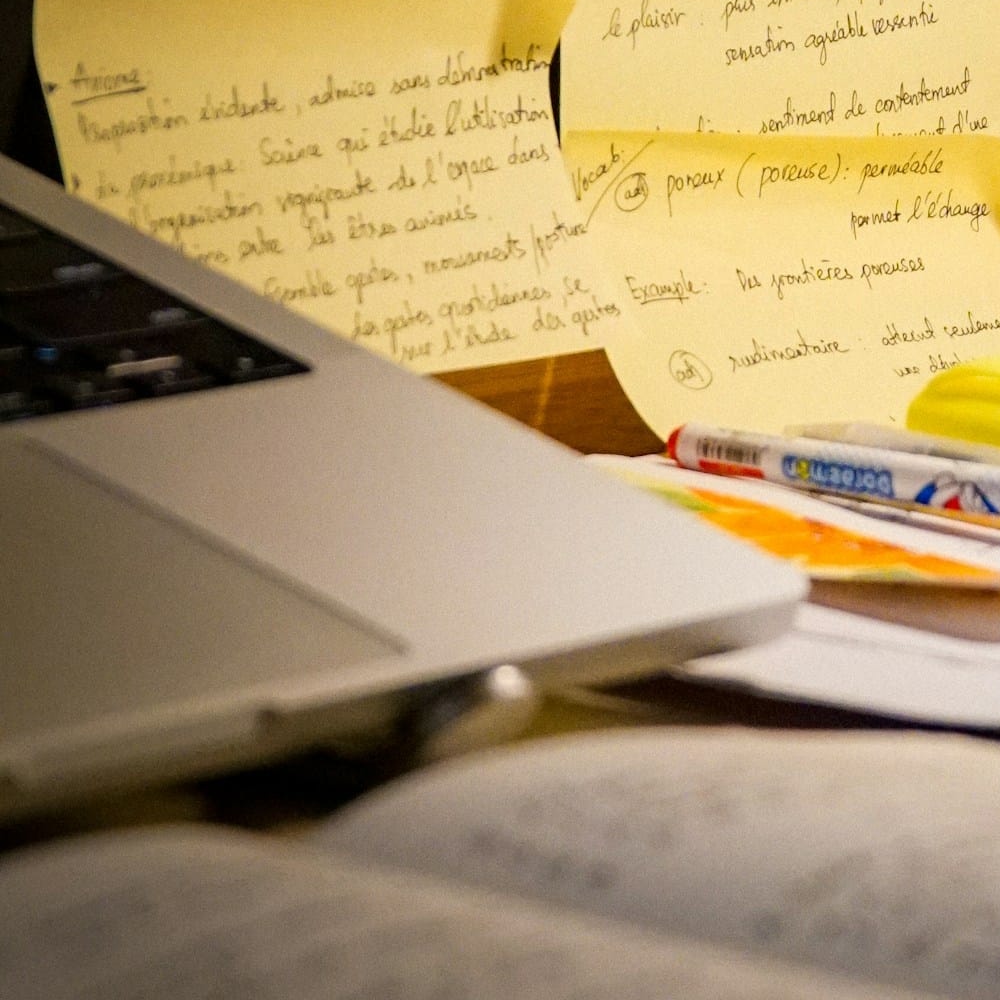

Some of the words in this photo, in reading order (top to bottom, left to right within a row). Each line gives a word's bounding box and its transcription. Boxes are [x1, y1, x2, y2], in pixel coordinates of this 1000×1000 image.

[602, 7, 622, 41] le
[725, 25, 796, 66] sensation
[759, 96, 836, 134] sentiment
[845, 90, 867, 118] de
[666, 166, 725, 217] poreux
[857, 148, 944, 194] perméable
[860, 257, 926, 289] poreuses
